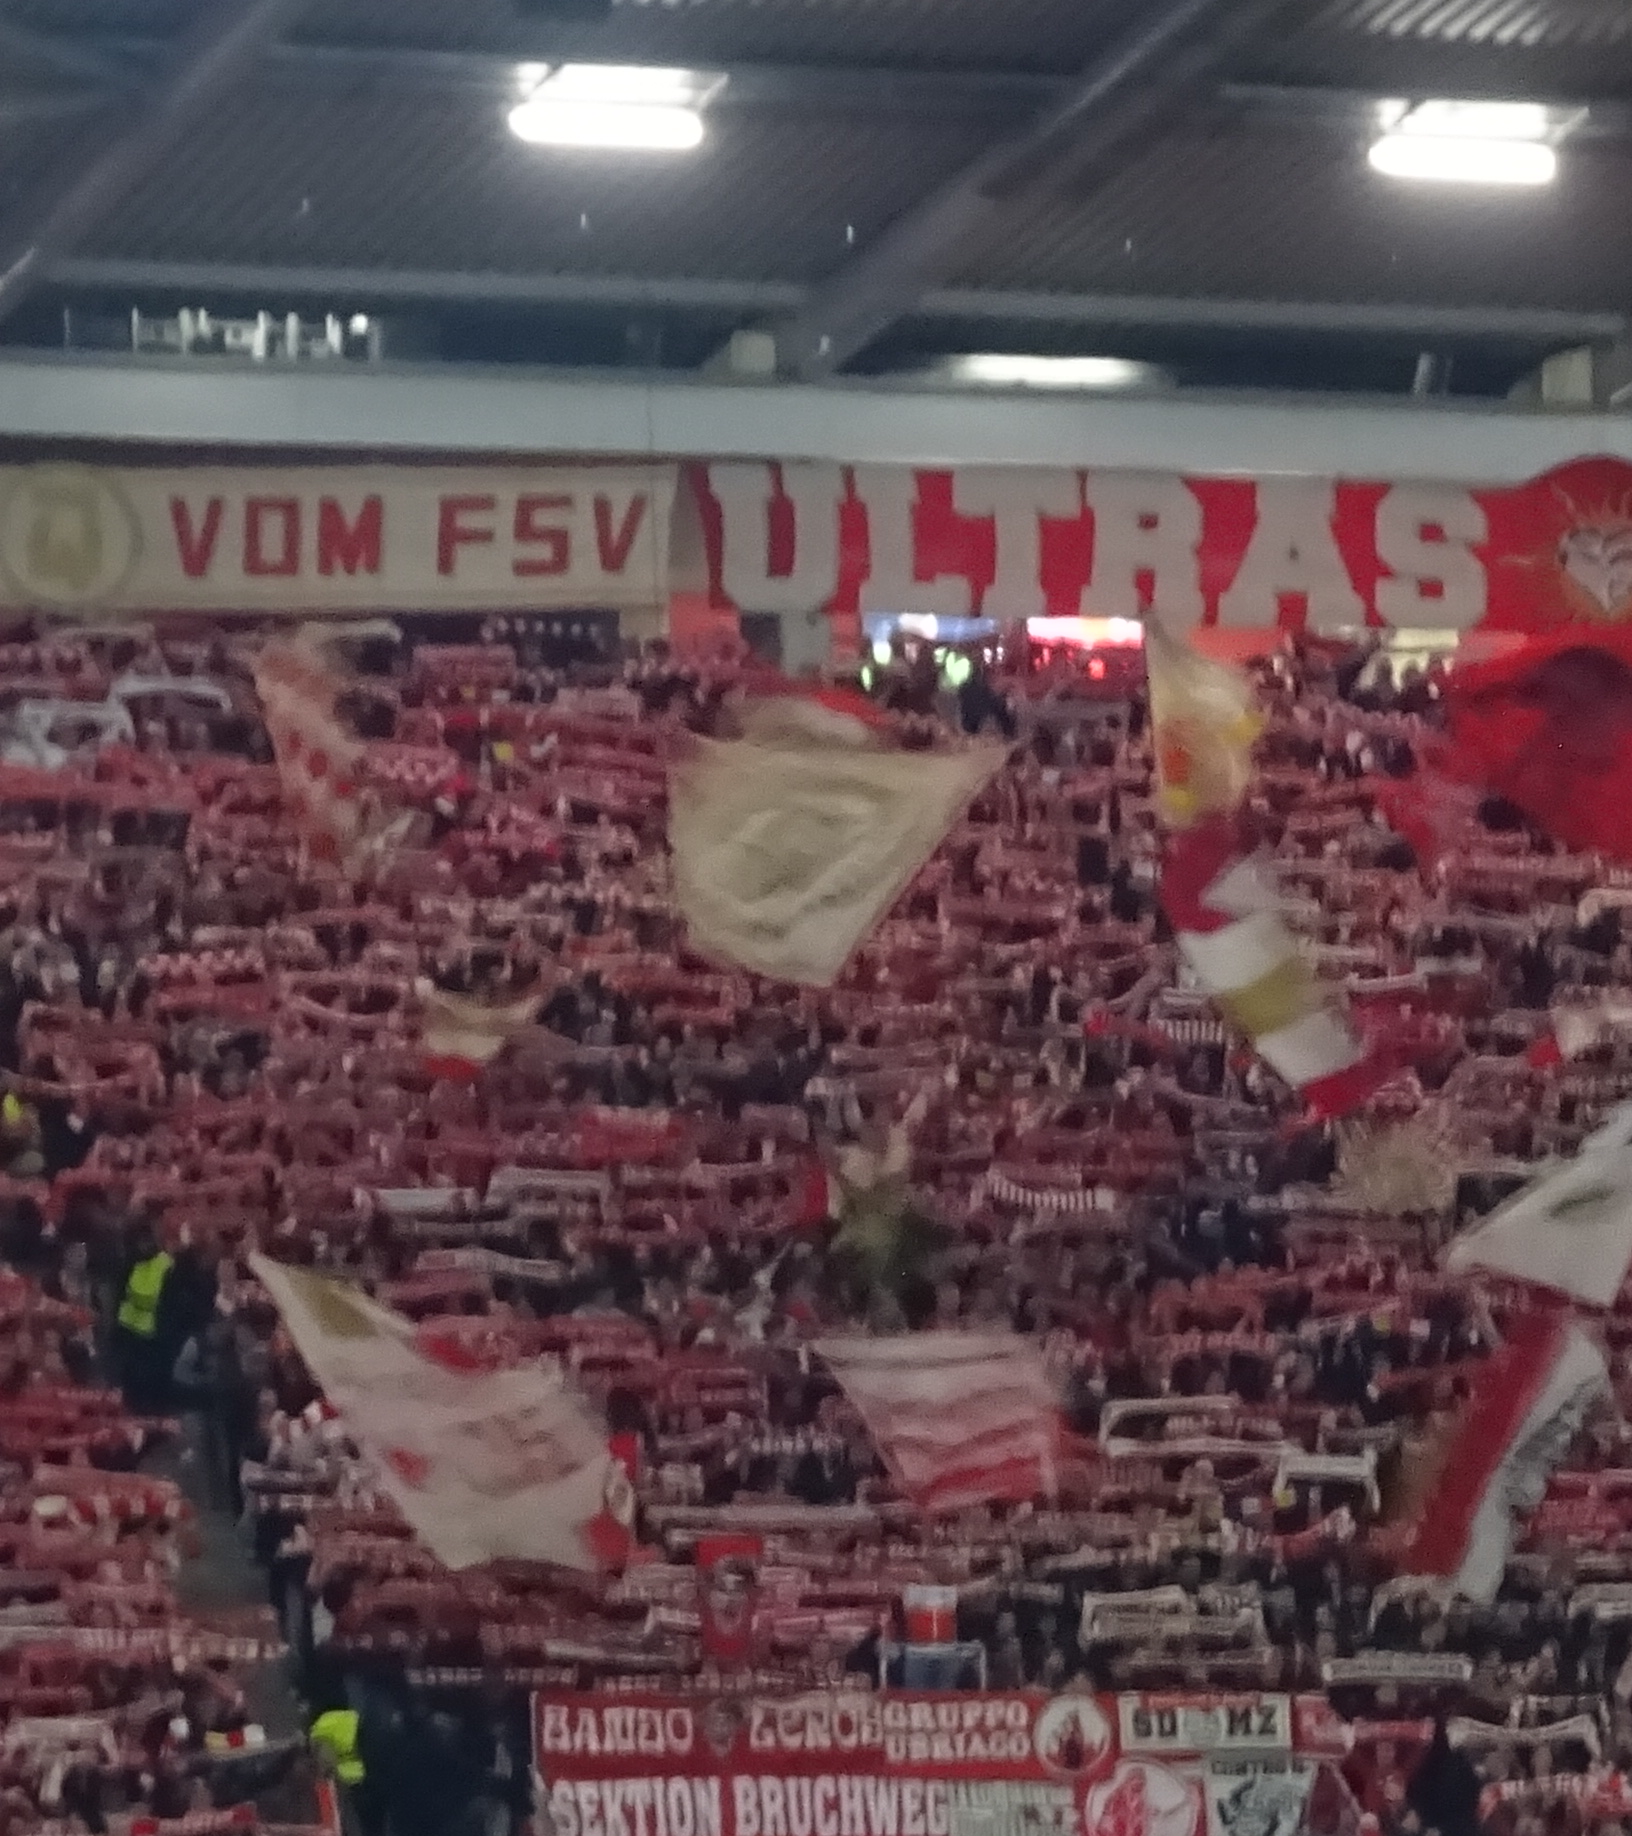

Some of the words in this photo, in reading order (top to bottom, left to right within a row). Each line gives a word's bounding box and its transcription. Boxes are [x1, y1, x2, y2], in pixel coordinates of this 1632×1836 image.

[170, 496, 382, 576] VOM
[436, 493, 649, 574] FSV
[704, 462, 1489, 630] ULTRAS
